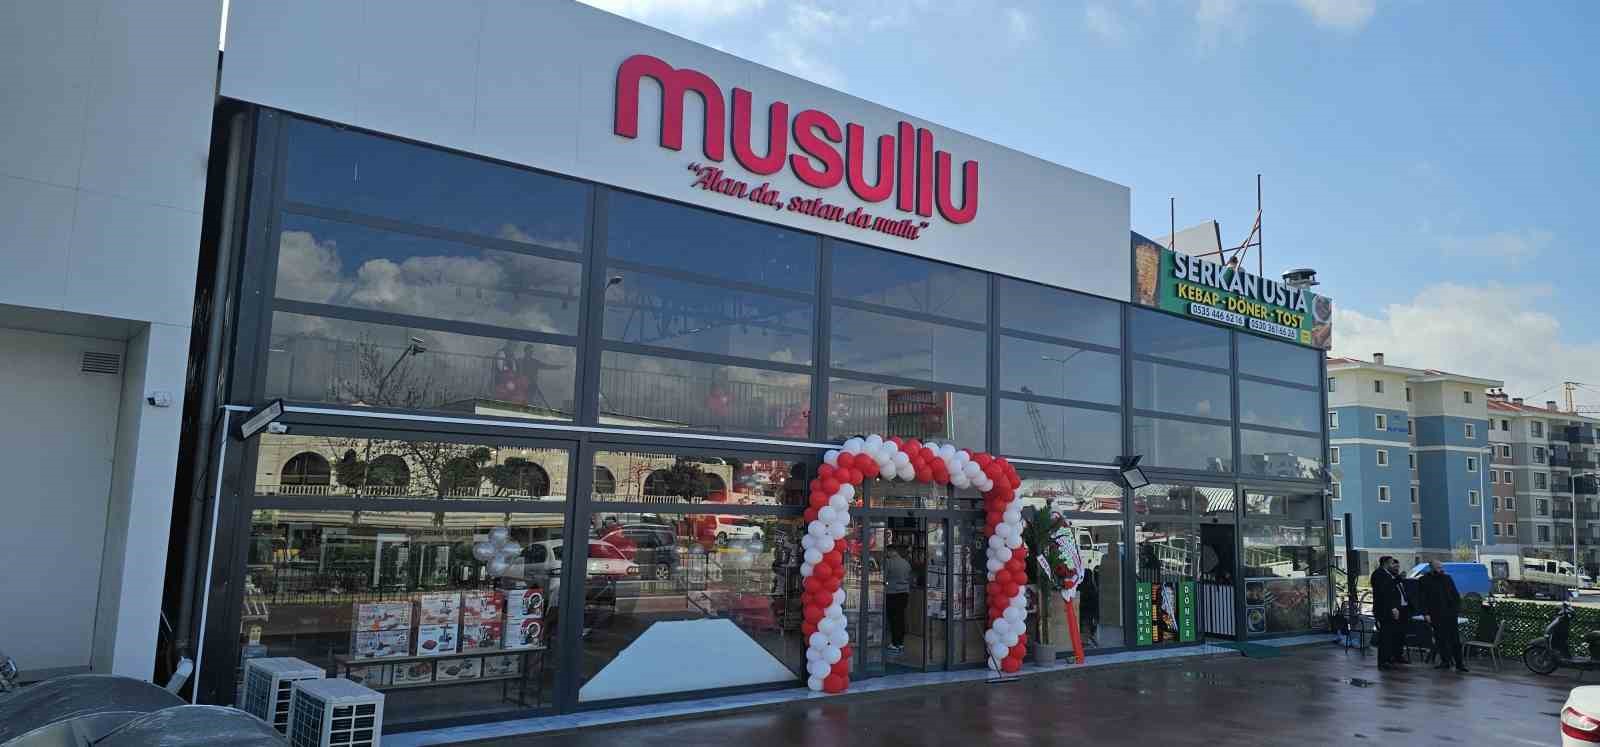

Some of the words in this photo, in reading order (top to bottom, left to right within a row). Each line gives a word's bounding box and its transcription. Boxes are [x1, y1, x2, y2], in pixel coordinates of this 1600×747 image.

[614, 54, 978, 224] musullu
[846, 207, 872, 229] da
[1174, 251, 1258, 297] SERKAN
[1262, 279, 1308, 313] USTA
[1178, 283, 1220, 306] KEBAP
[1228, 294, 1269, 319] DÖNER
[1276, 310, 1305, 328] TOST
